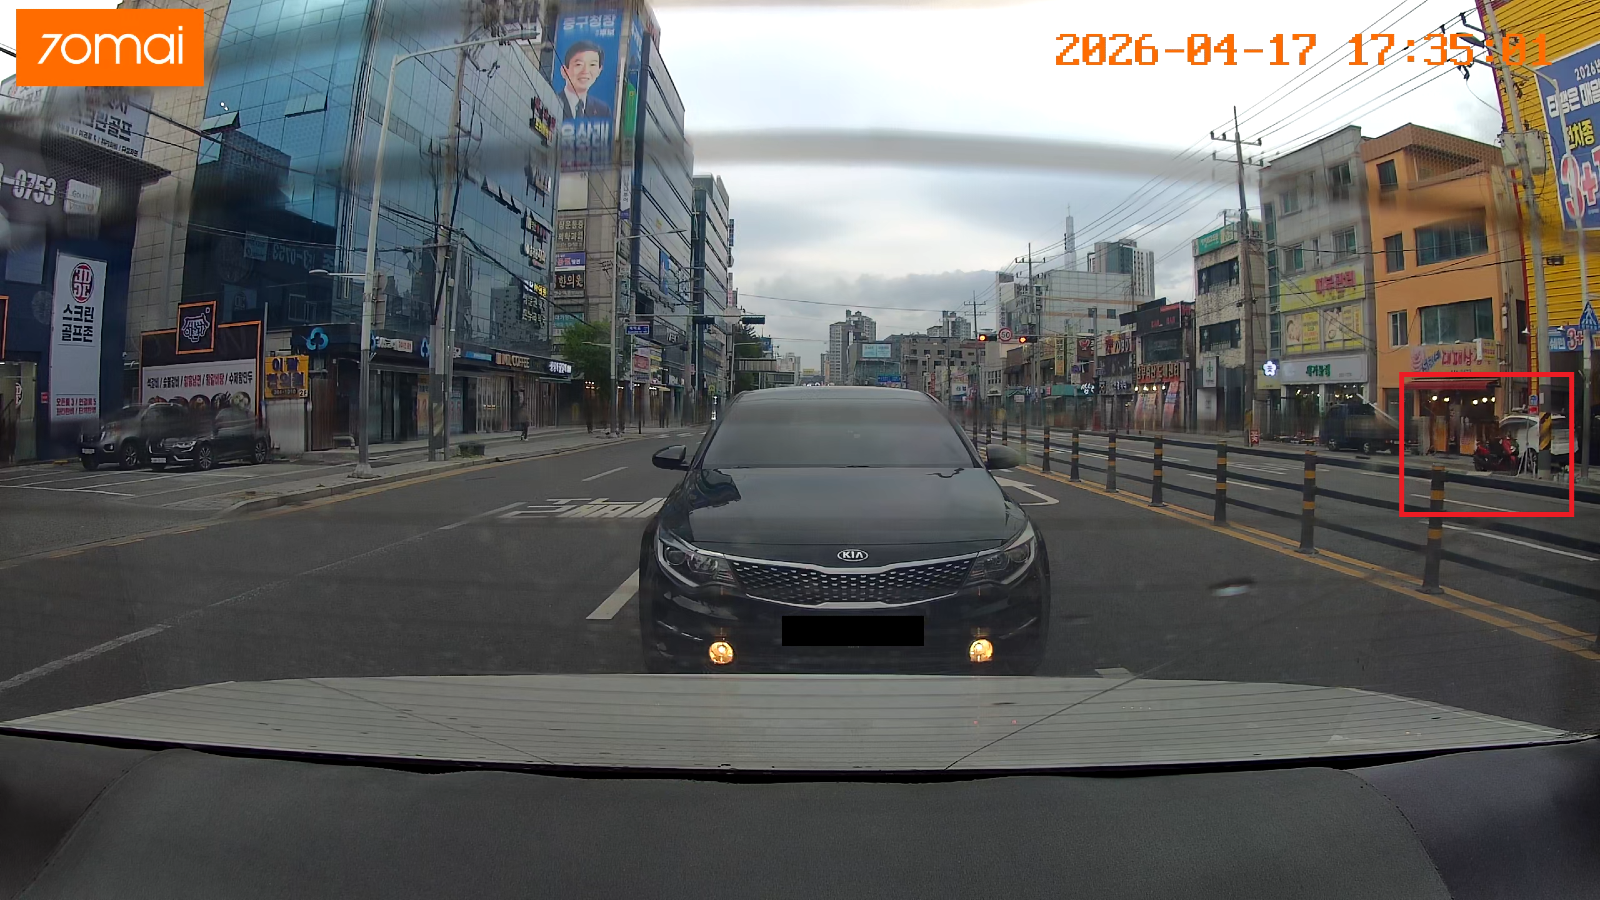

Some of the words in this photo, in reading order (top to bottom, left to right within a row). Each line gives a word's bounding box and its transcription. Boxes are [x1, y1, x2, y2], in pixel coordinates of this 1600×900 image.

[563, 14, 616, 30] 중구청장
[70, 106, 133, 142] 린골프
[62, 303, 95, 323] 스크린
[61, 323, 94, 343] 골프존
[842, 550, 865, 560] KIA
